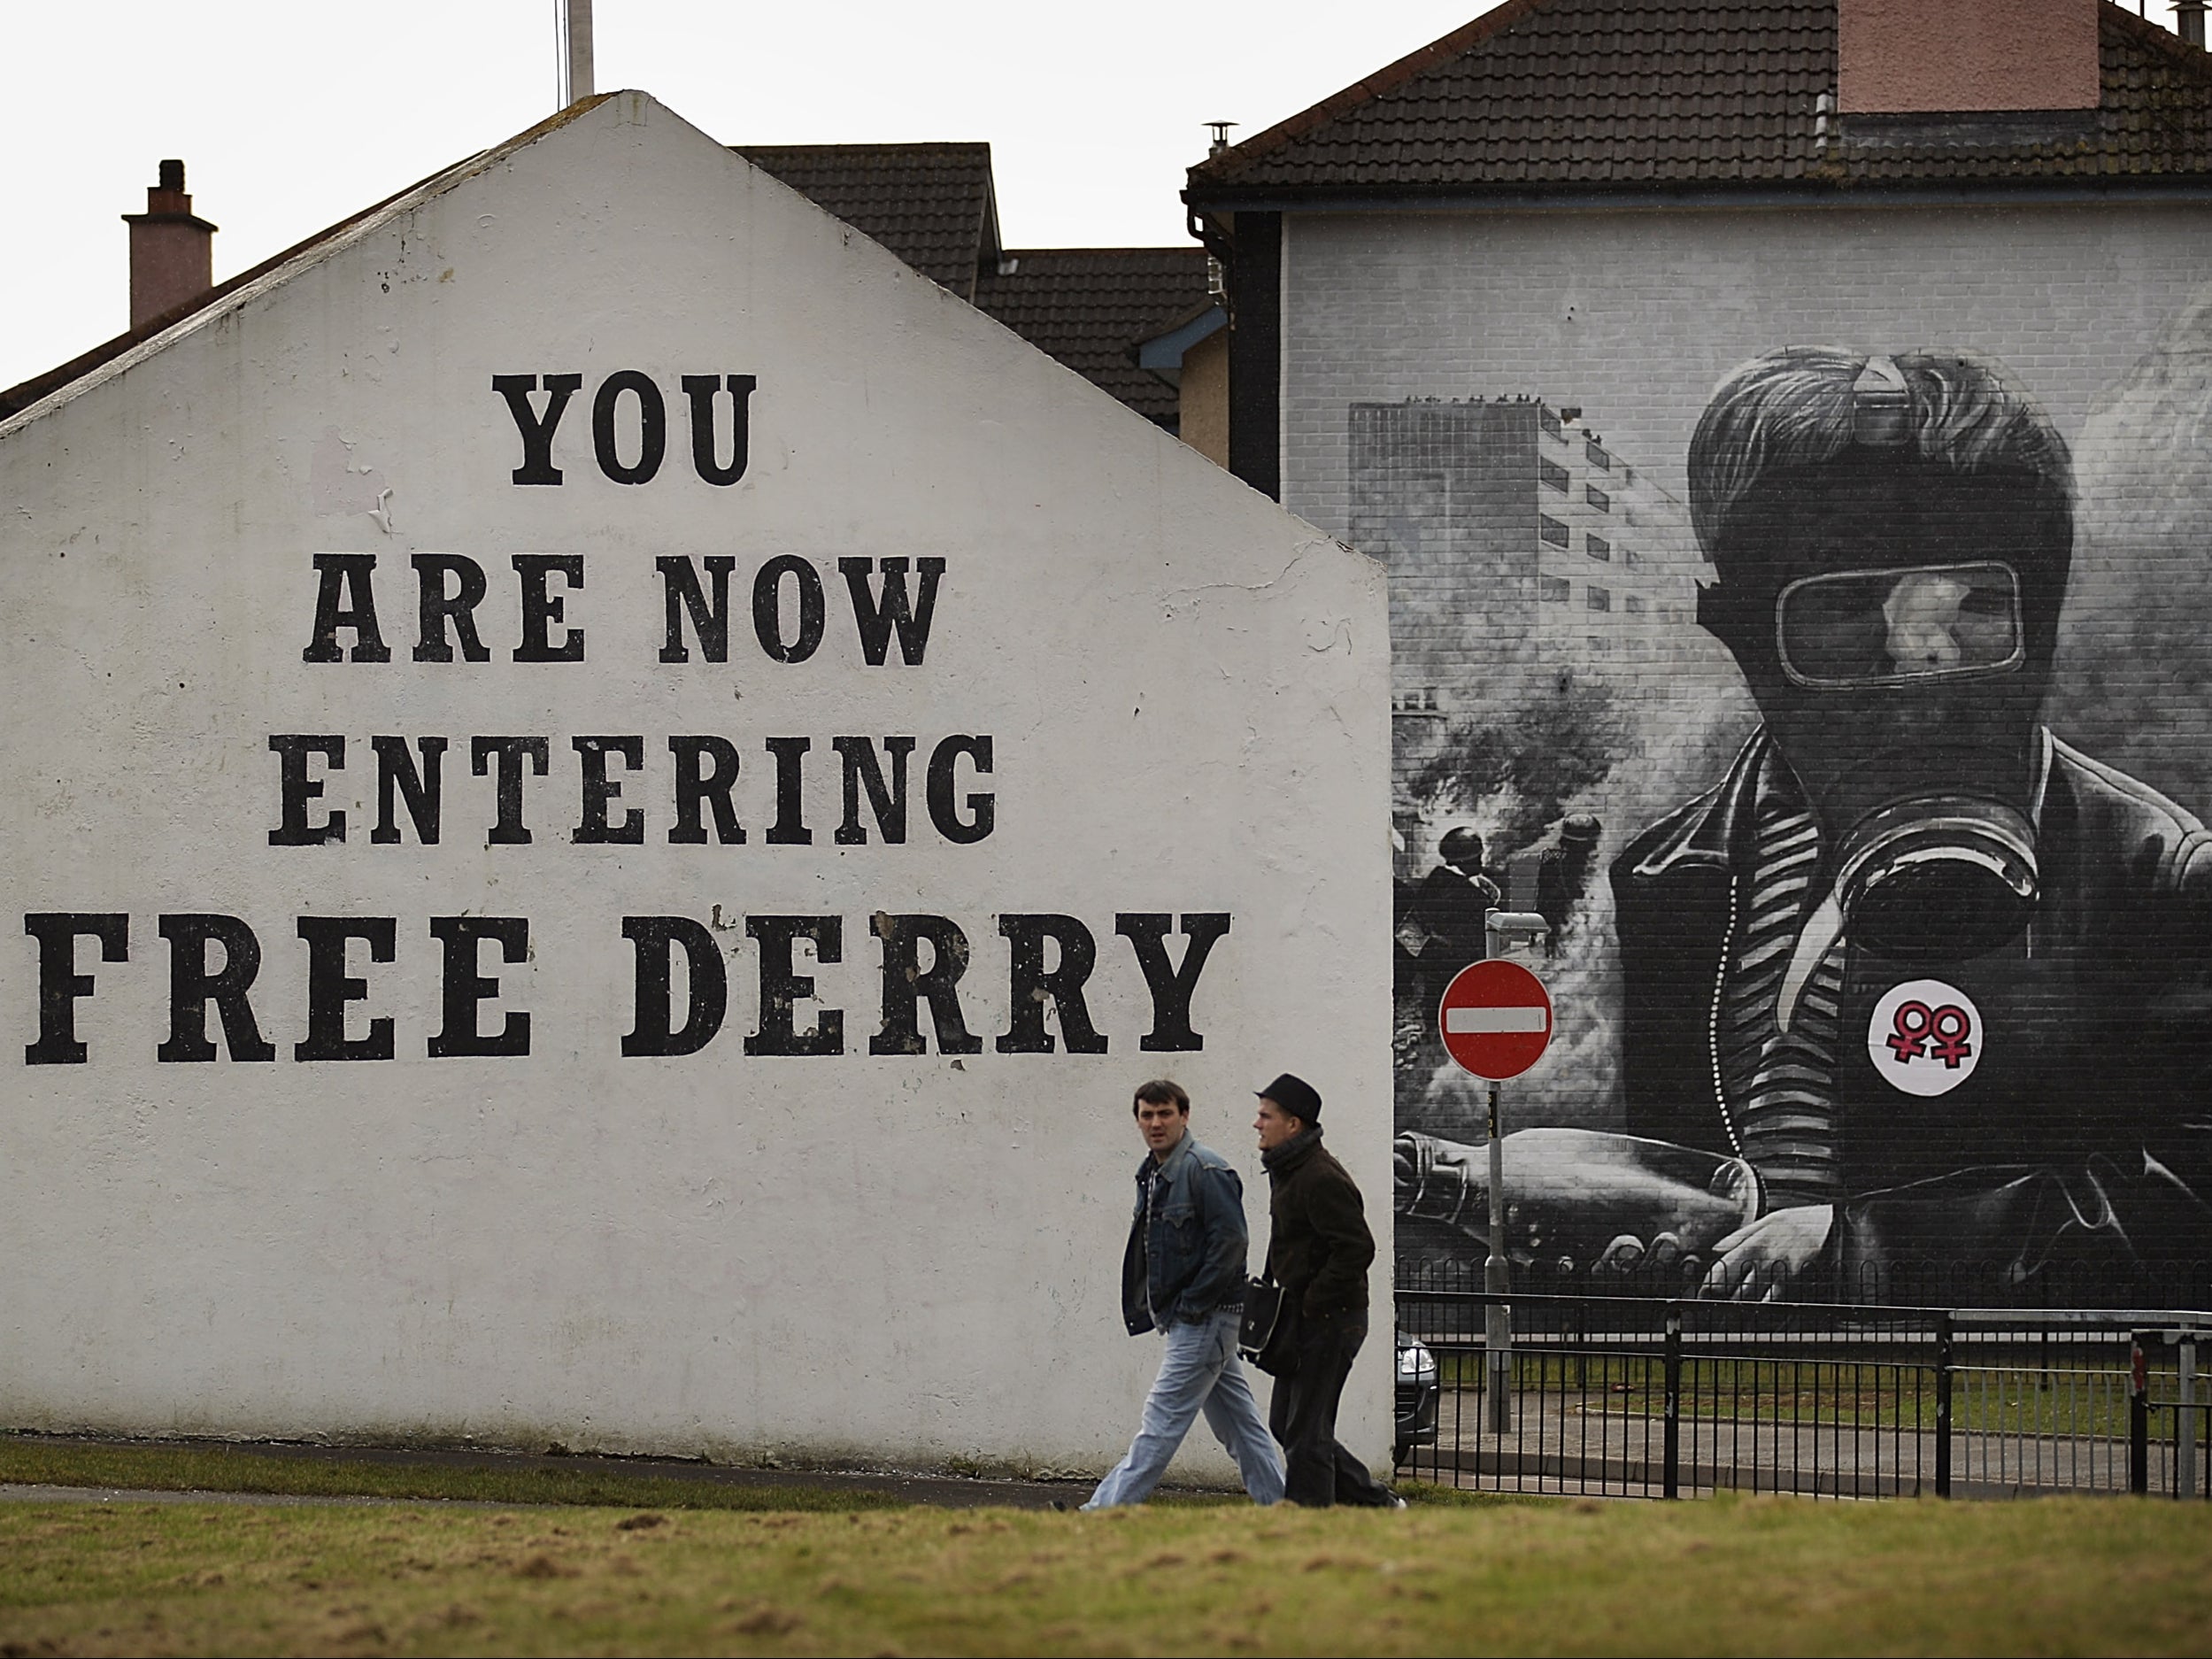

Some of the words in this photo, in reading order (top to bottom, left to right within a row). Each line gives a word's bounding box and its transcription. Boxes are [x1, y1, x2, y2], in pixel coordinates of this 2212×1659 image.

[492, 370, 757, 487] YOU
[302, 552, 585, 664] ARE
[655, 553, 946, 667] NOW
[267, 734, 997, 846] ENTERING
[23, 912, 531, 1066] FREE
[620, 911, 1232, 1058] DERRY
